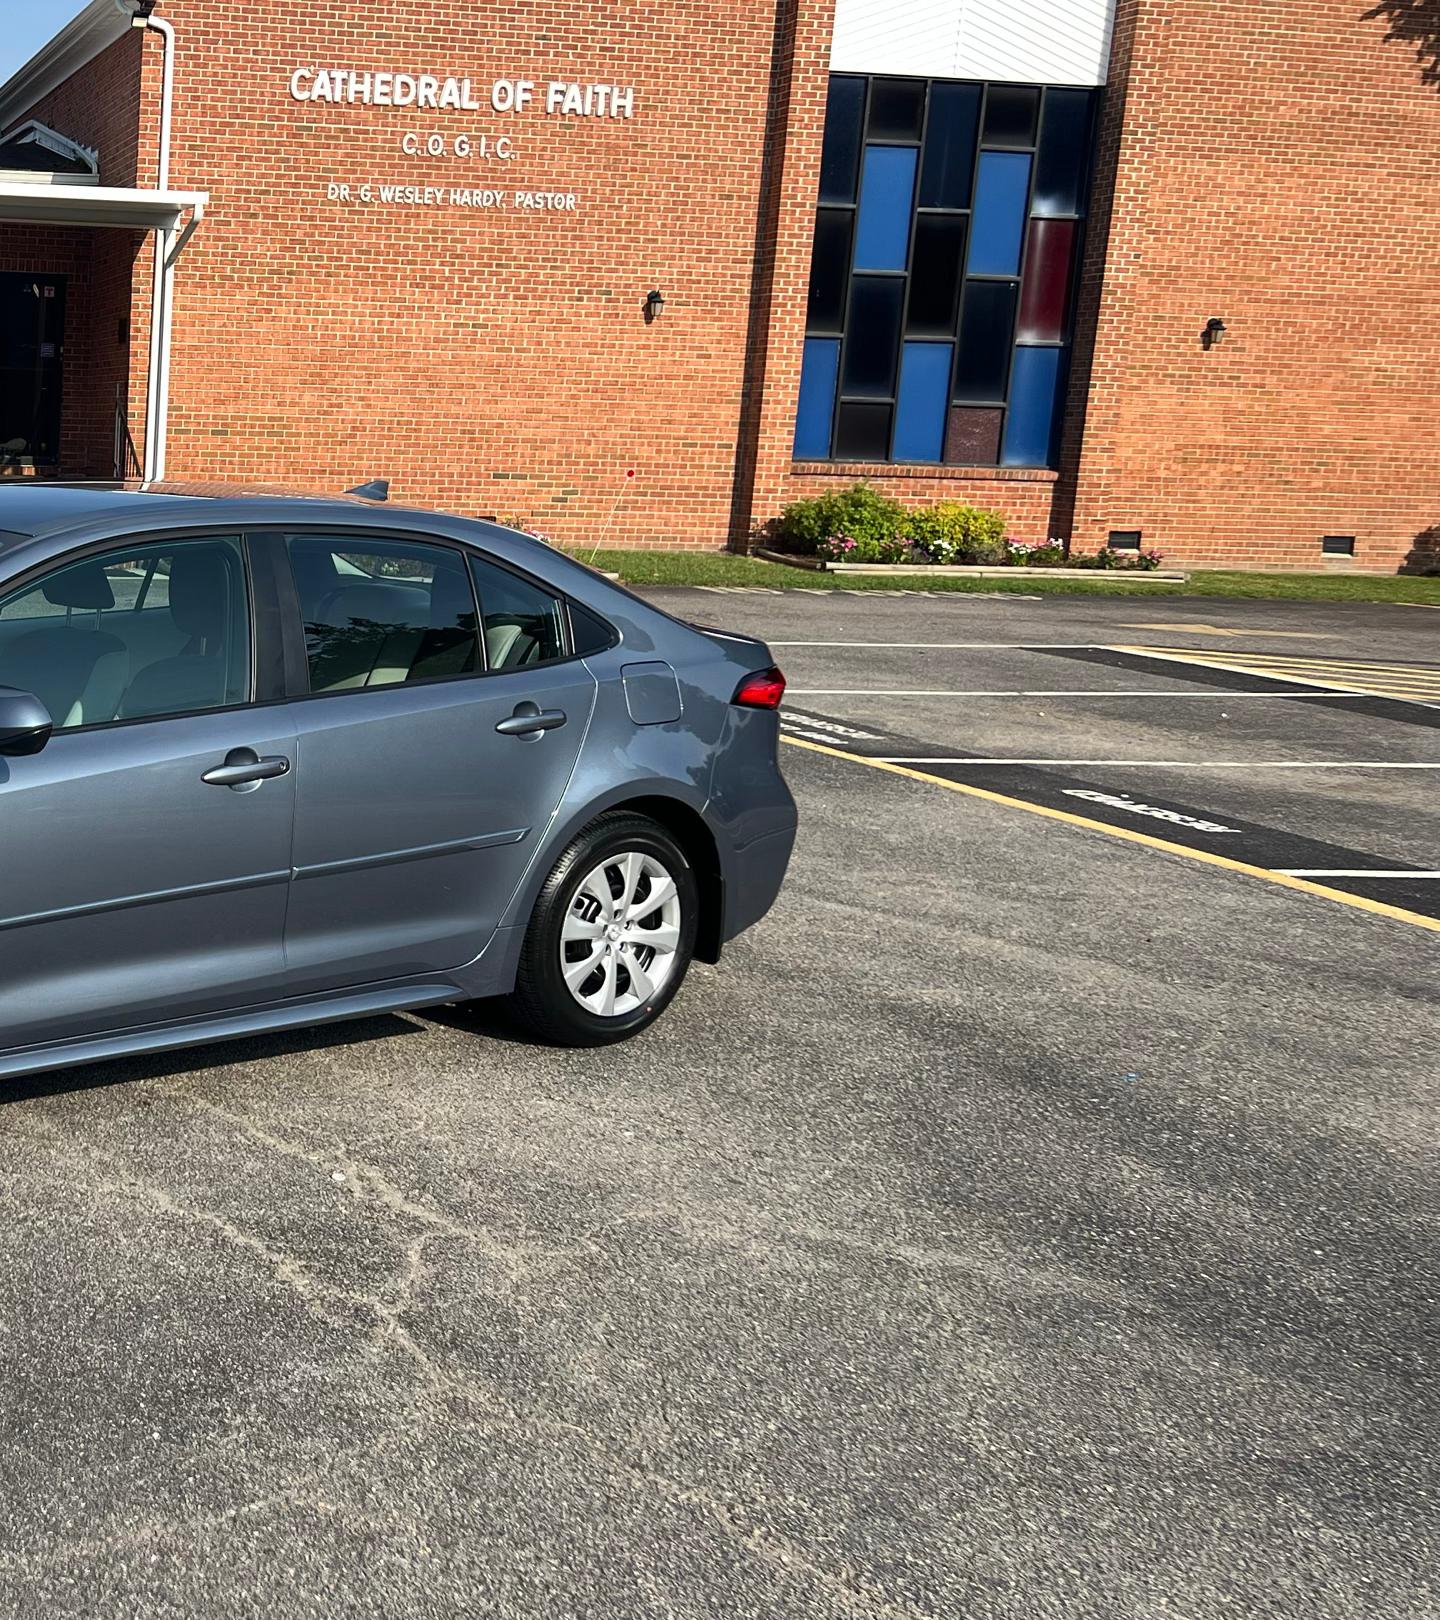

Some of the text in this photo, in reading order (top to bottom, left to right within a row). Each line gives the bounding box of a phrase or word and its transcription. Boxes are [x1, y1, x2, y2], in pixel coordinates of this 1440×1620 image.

[290, 68, 634, 118] CATHEDRAL OF FAITH
[327, 184, 354, 202] DR.
[360, 186, 376, 203] G.
[379, 186, 444, 206] WESLEY
[514, 191, 576, 211] PASTOR
